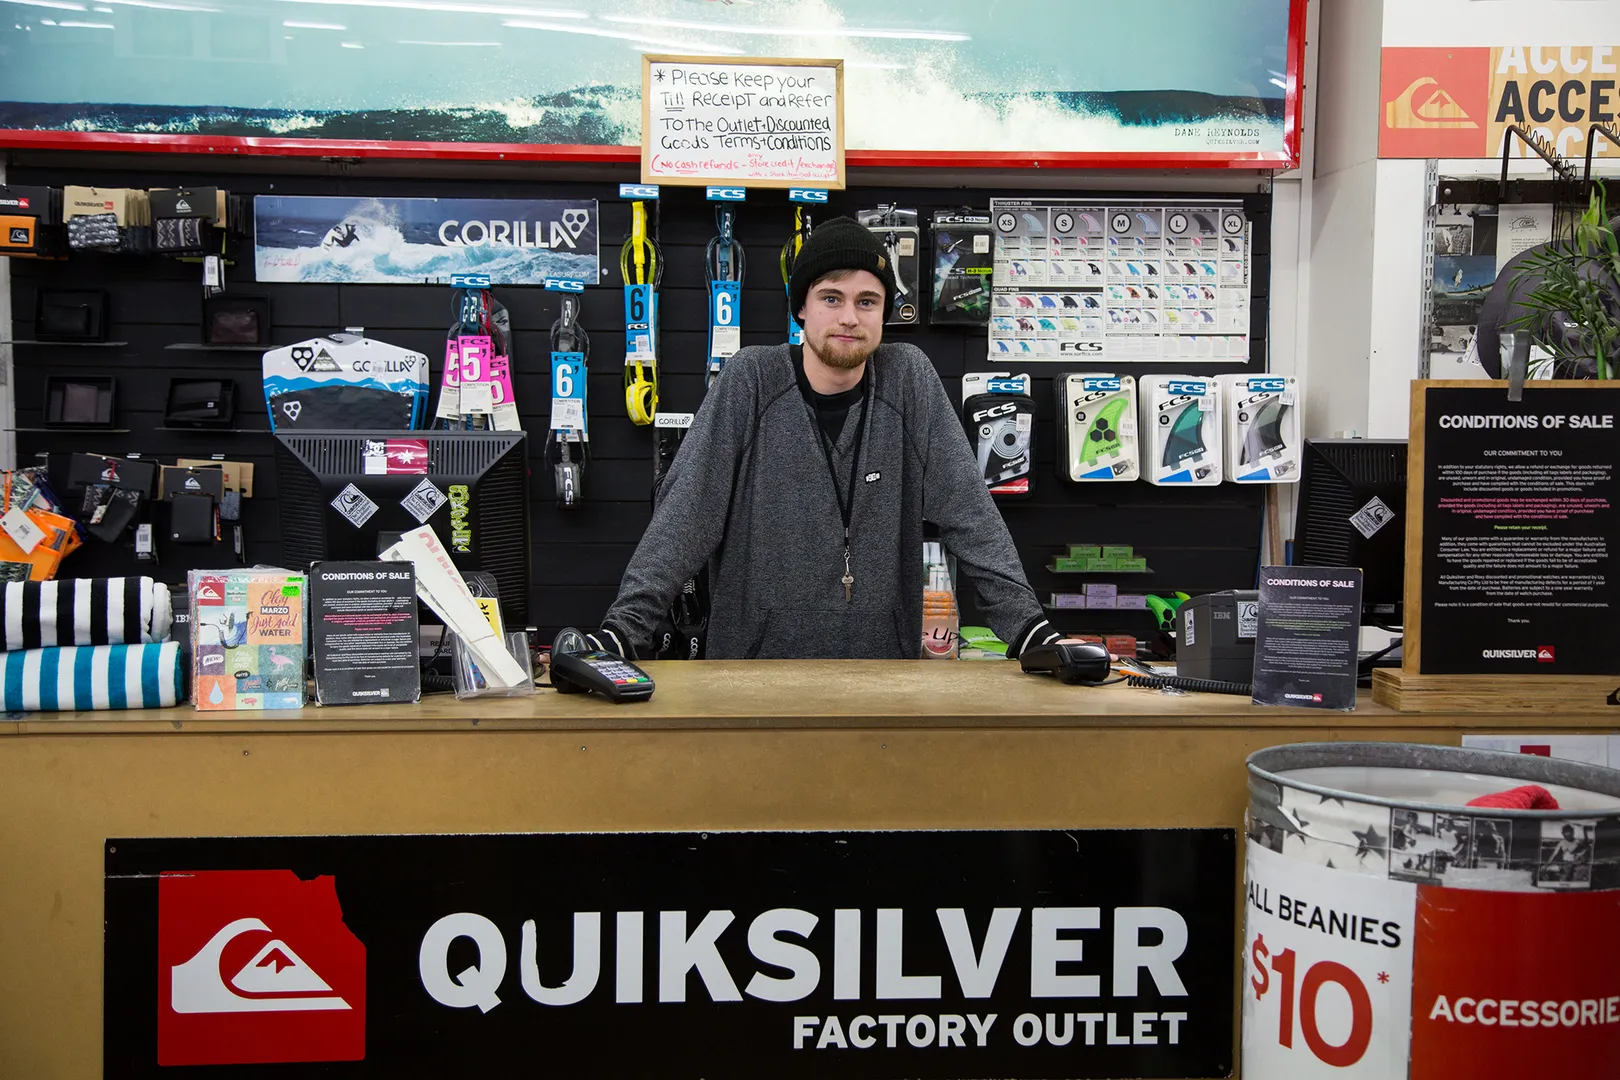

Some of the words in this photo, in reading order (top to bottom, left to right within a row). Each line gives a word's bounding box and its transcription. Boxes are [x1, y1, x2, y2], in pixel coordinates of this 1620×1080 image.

[1496, 46, 1620, 74] ACCE
[672, 69, 728, 85] Please
[777, 76, 815, 93] your
[660, 92, 684, 106] Till
[760, 95, 786, 107] and
[788, 94, 832, 108] Refer
[1494, 80, 1620, 122] ACCE
[686, 118, 713, 132] the
[1174, 128, 1200, 138] DANE
[1207, 128, 1260, 138] REYNOLDS
[661, 135, 709, 149] Goods
[1496, 127, 1617, 158] ACCE
[699, 160, 739, 170] refunds
[770, 159, 794, 168] credit
[620, 186, 659, 196] FCS
[707, 189, 745, 198] FCS
[790, 190, 827, 200] FCS
[451, 277, 489, 286] FCS
[546, 280, 584, 290] FCS
[1060, 342, 1103, 351] FCS
[352, 360, 412, 372] GOILLA
[988, 382, 1023, 390] FCS
[1084, 380, 1120, 388] FCS
[1169, 384, 1205, 392] FCS
[1249, 381, 1284, 389] FCS
[1074, 390, 1106, 407] FCS
[1158, 394, 1191, 411] FCS
[1238, 391, 1270, 409] FCS
[973, 402, 1017, 422] FCS
[1439, 415, 1538, 429] CONDITIONS
[1542, 415, 1565, 429] OF
[1569, 415, 1613, 429] SALE
[564, 467, 573, 504] FCS
[1267, 578, 1318, 587] CONDITIONS
[261, 590, 289, 606] Clay
[1483, 650, 1536, 658] QUIKSILVER
[1248, 880, 1273, 916] ALL
[1279, 894, 1401, 949] BEANIES
[419, 906, 1189, 1014] QUIKSILVER
[1430, 994, 1620, 1028] ACCESSORIE
[793, 1014, 998, 1049] FACTORY
[1013, 1011, 1188, 1046] OUTLET
